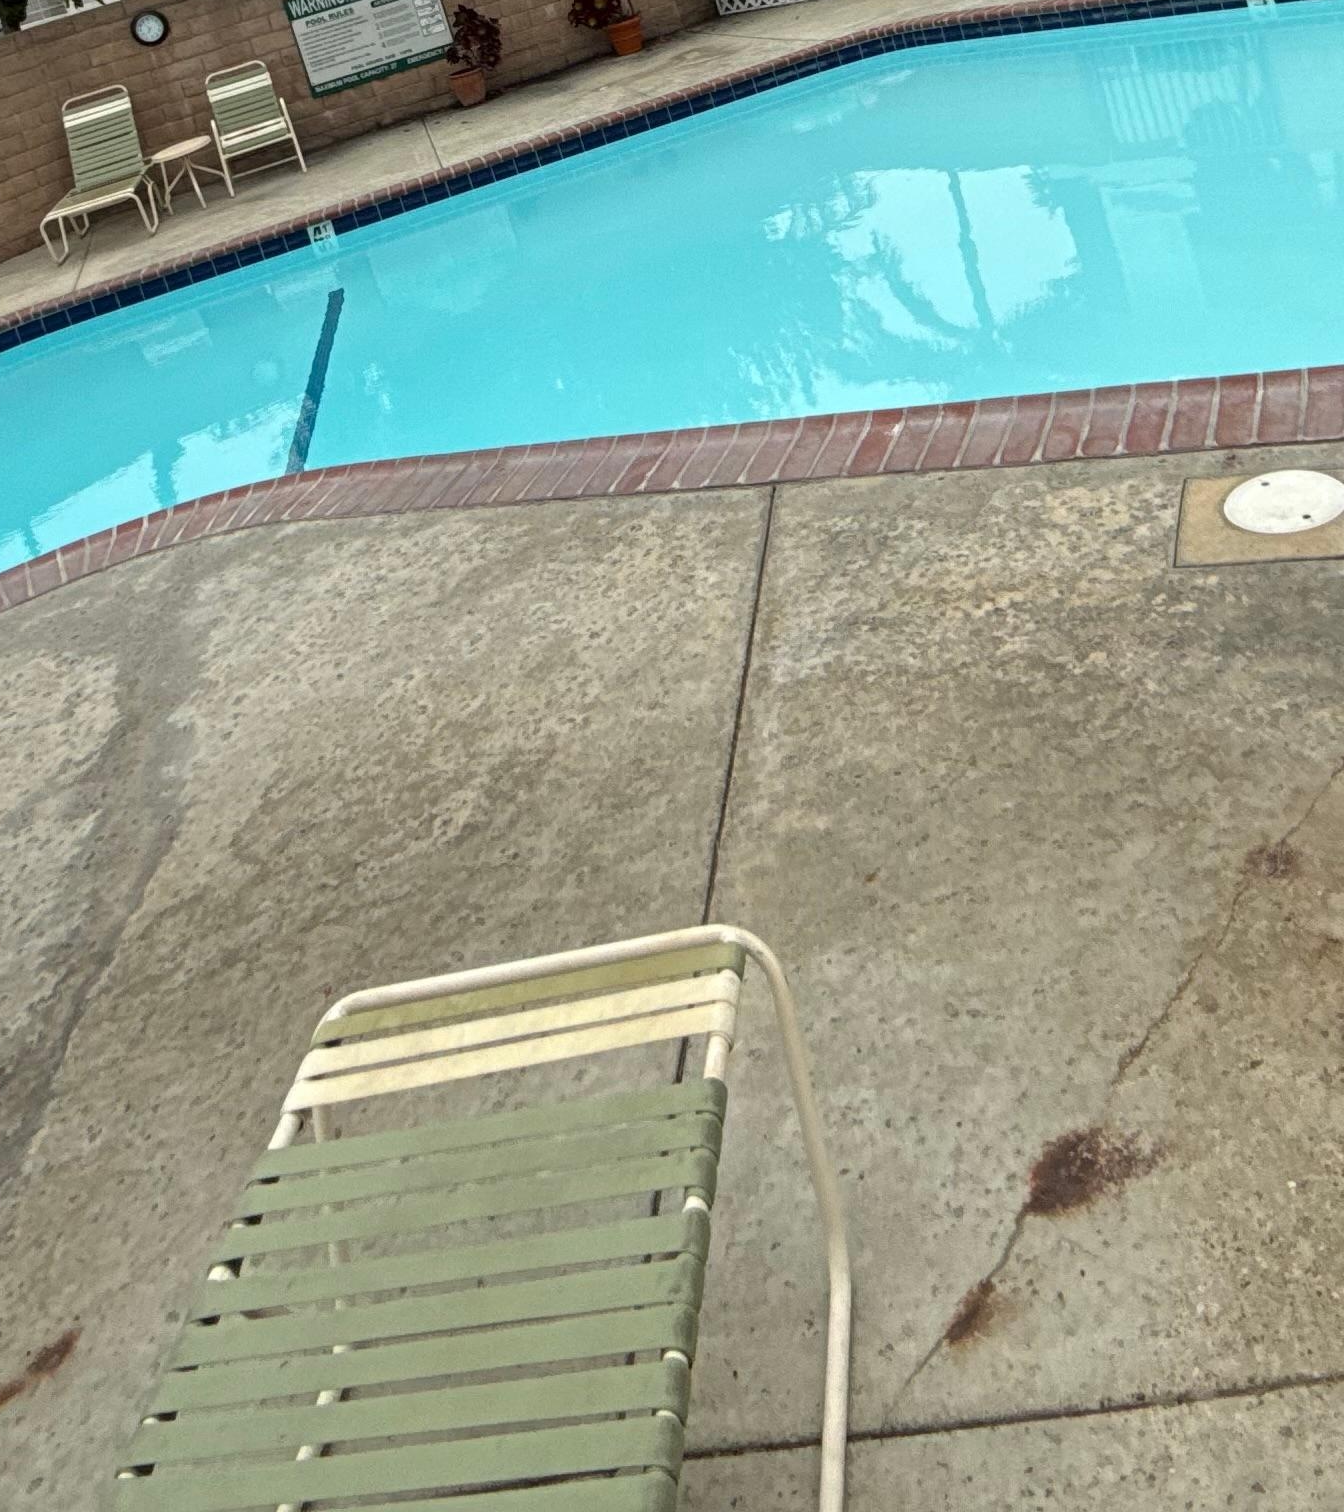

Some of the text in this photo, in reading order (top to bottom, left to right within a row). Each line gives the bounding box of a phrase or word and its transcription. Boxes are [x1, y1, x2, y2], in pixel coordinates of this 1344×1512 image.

[306, 8, 354, 28] POOL RULES
[343, 74, 360, 84] POOL
